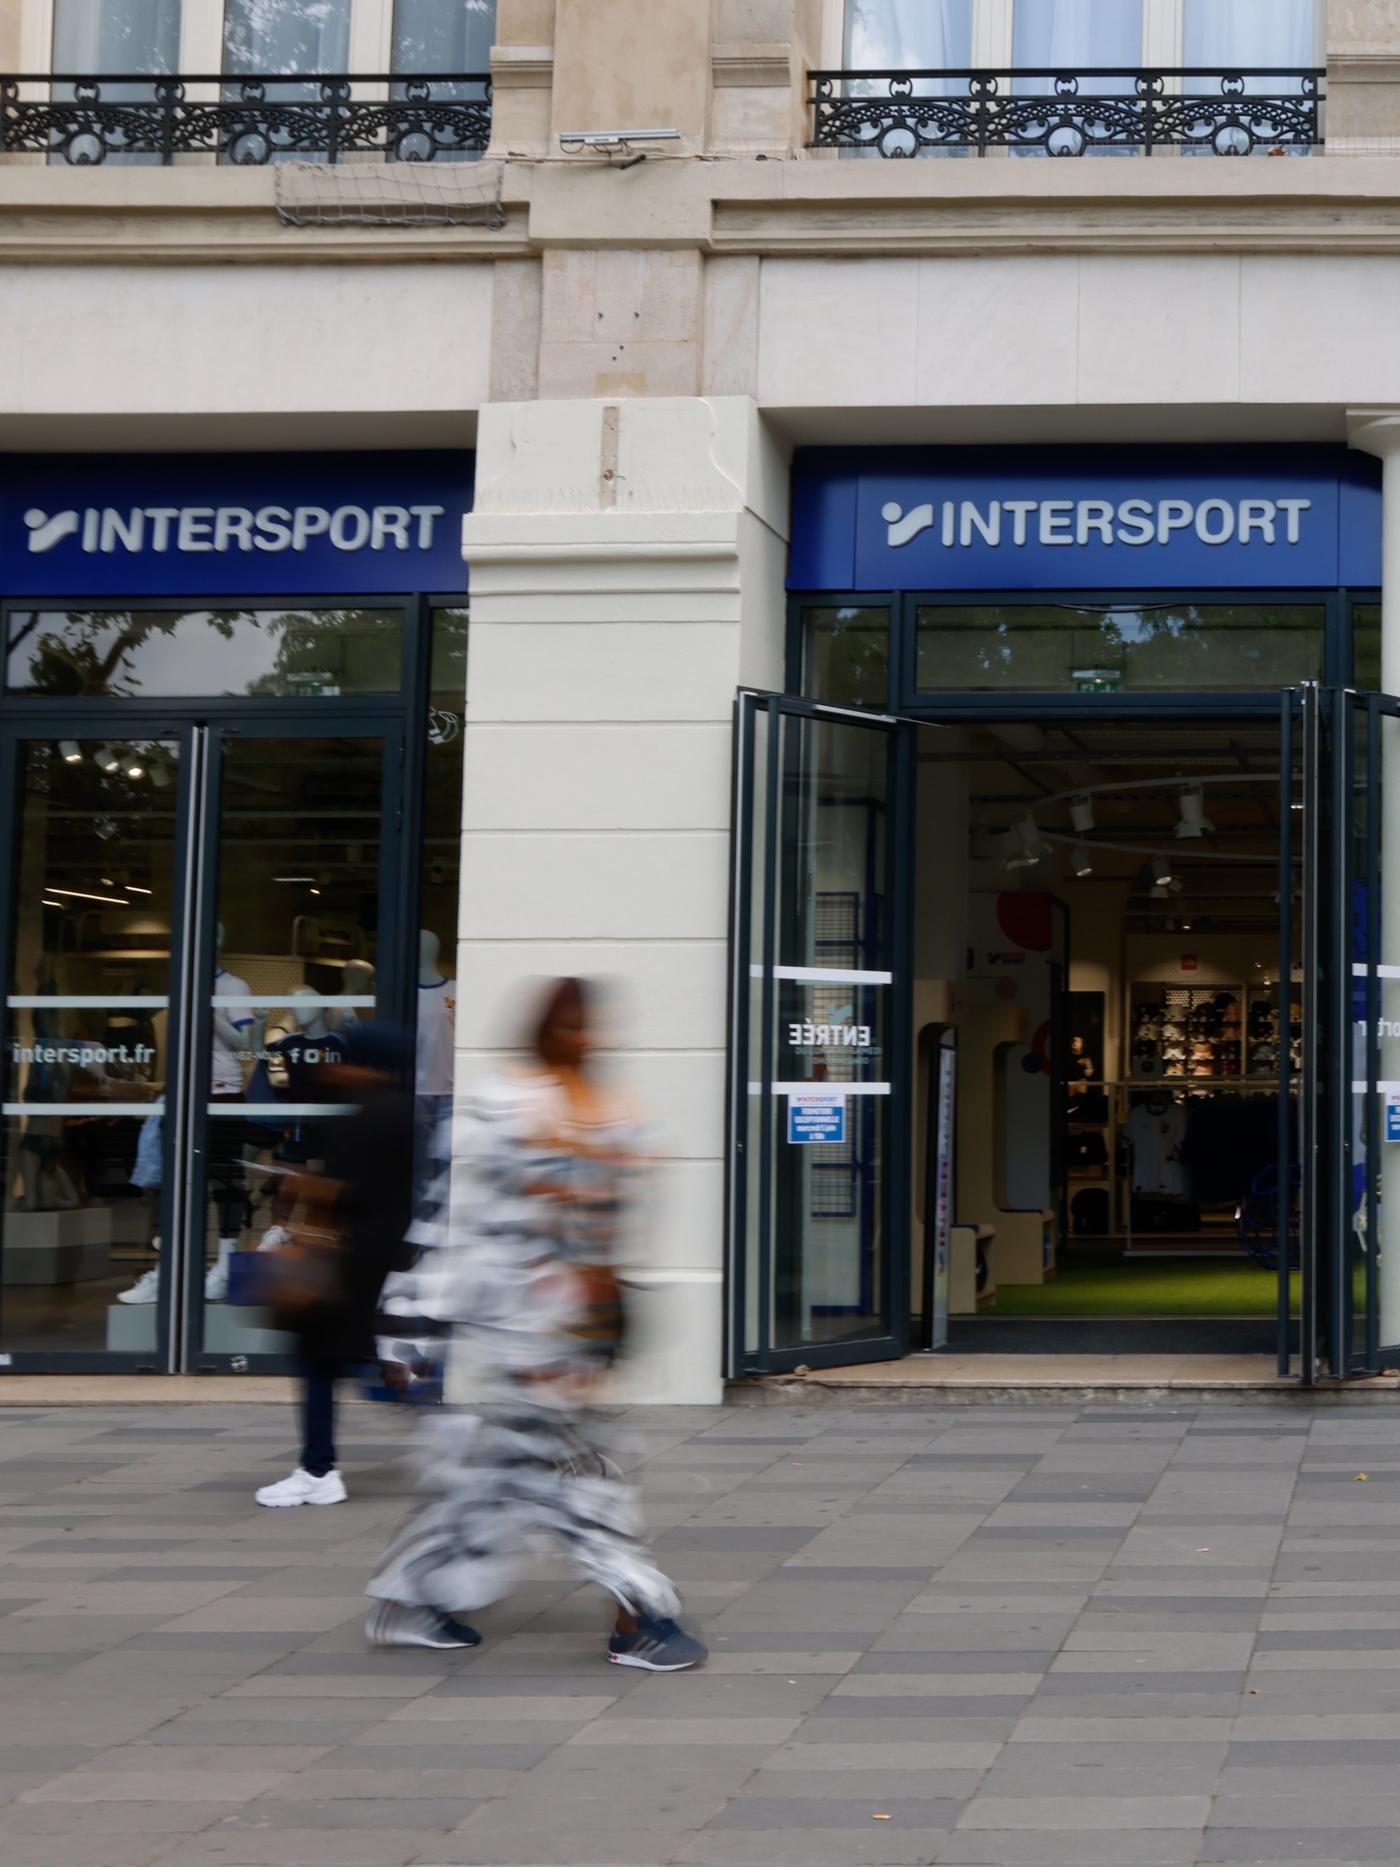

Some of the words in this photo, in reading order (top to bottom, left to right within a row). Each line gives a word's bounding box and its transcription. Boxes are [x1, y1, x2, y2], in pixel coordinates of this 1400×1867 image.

[82, 505, 445, 554] INTERSPORT
[941, 498, 1311, 547] INTERSPORT
[12, 1043, 156, 1068] intersport.fr
